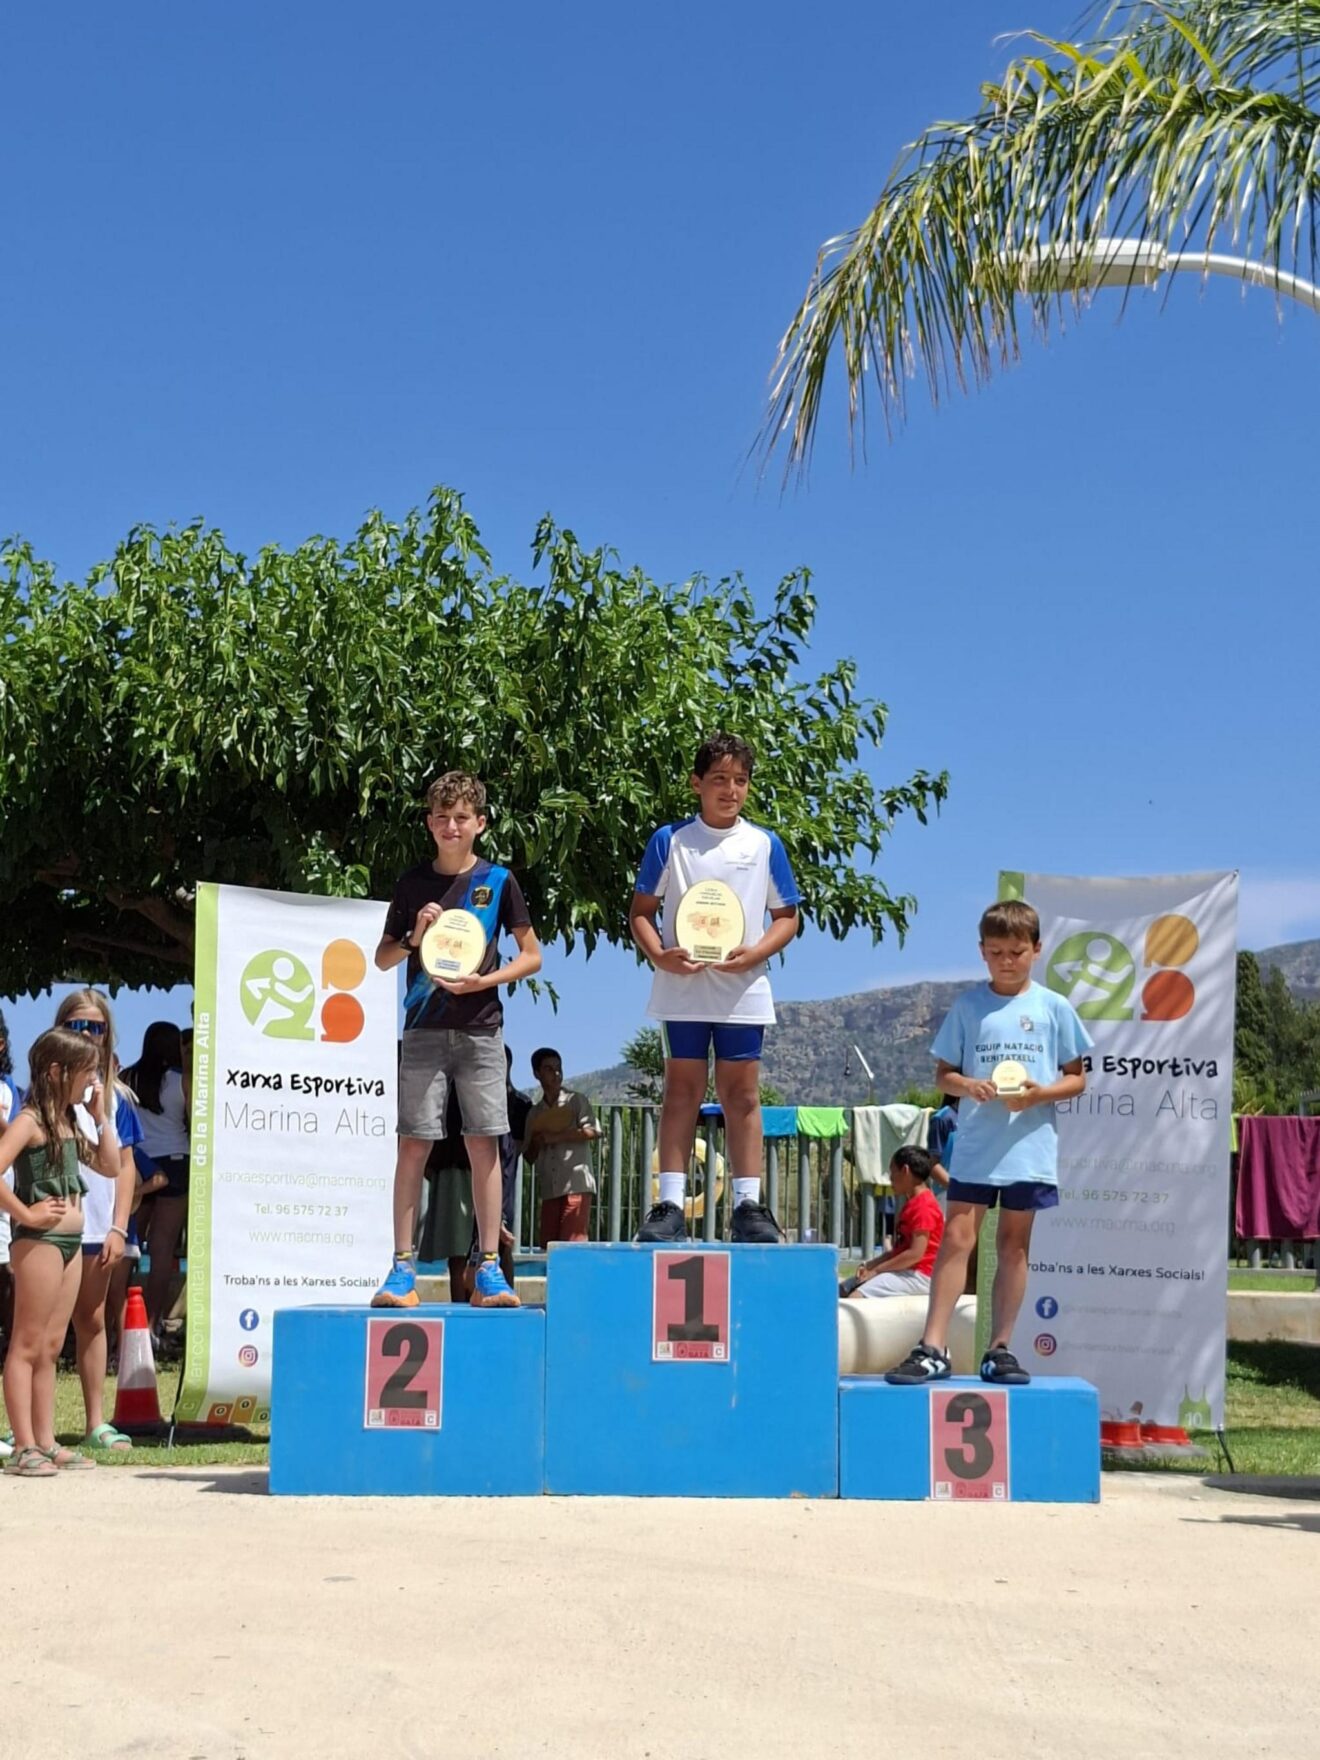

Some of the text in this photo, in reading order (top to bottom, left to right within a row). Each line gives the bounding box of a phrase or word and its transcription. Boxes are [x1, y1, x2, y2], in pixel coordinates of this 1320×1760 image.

[196, 1012, 210, 1049] Alta
[975, 1043, 1001, 1053] EQUIP
[1103, 1055, 1218, 1079] Esportiva
[195, 1054, 208, 1117] Marina
[290, 1073, 385, 1097] Esportiva
[1055, 1087, 1218, 1120] arina Alta
[195, 1122, 207, 1138] la
[224, 1102, 386, 1137] Marina Alta
[194, 1143, 207, 1166] de
[1082, 1189, 1098, 1200] 96
[1102, 1190, 1128, 1202] 575
[1132, 1191, 1148, 1203] 72
[1152, 1192, 1169, 1204] 37
[190, 1172, 207, 1259] Comarcal
[254, 1203, 349, 1217] Tel. 96 575 72 37
[249, 1230, 354, 1247] www.macma.org
[224, 1274, 380, 1288] Troba'ns a les Xarxes Socials!
[1026, 1261, 1205, 1281] roba'ns a les Xarxes Socials!
[667, 1256, 719, 1342] 1
[379, 1322, 429, 1409] 2
[944, 1392, 994, 1480] 3
